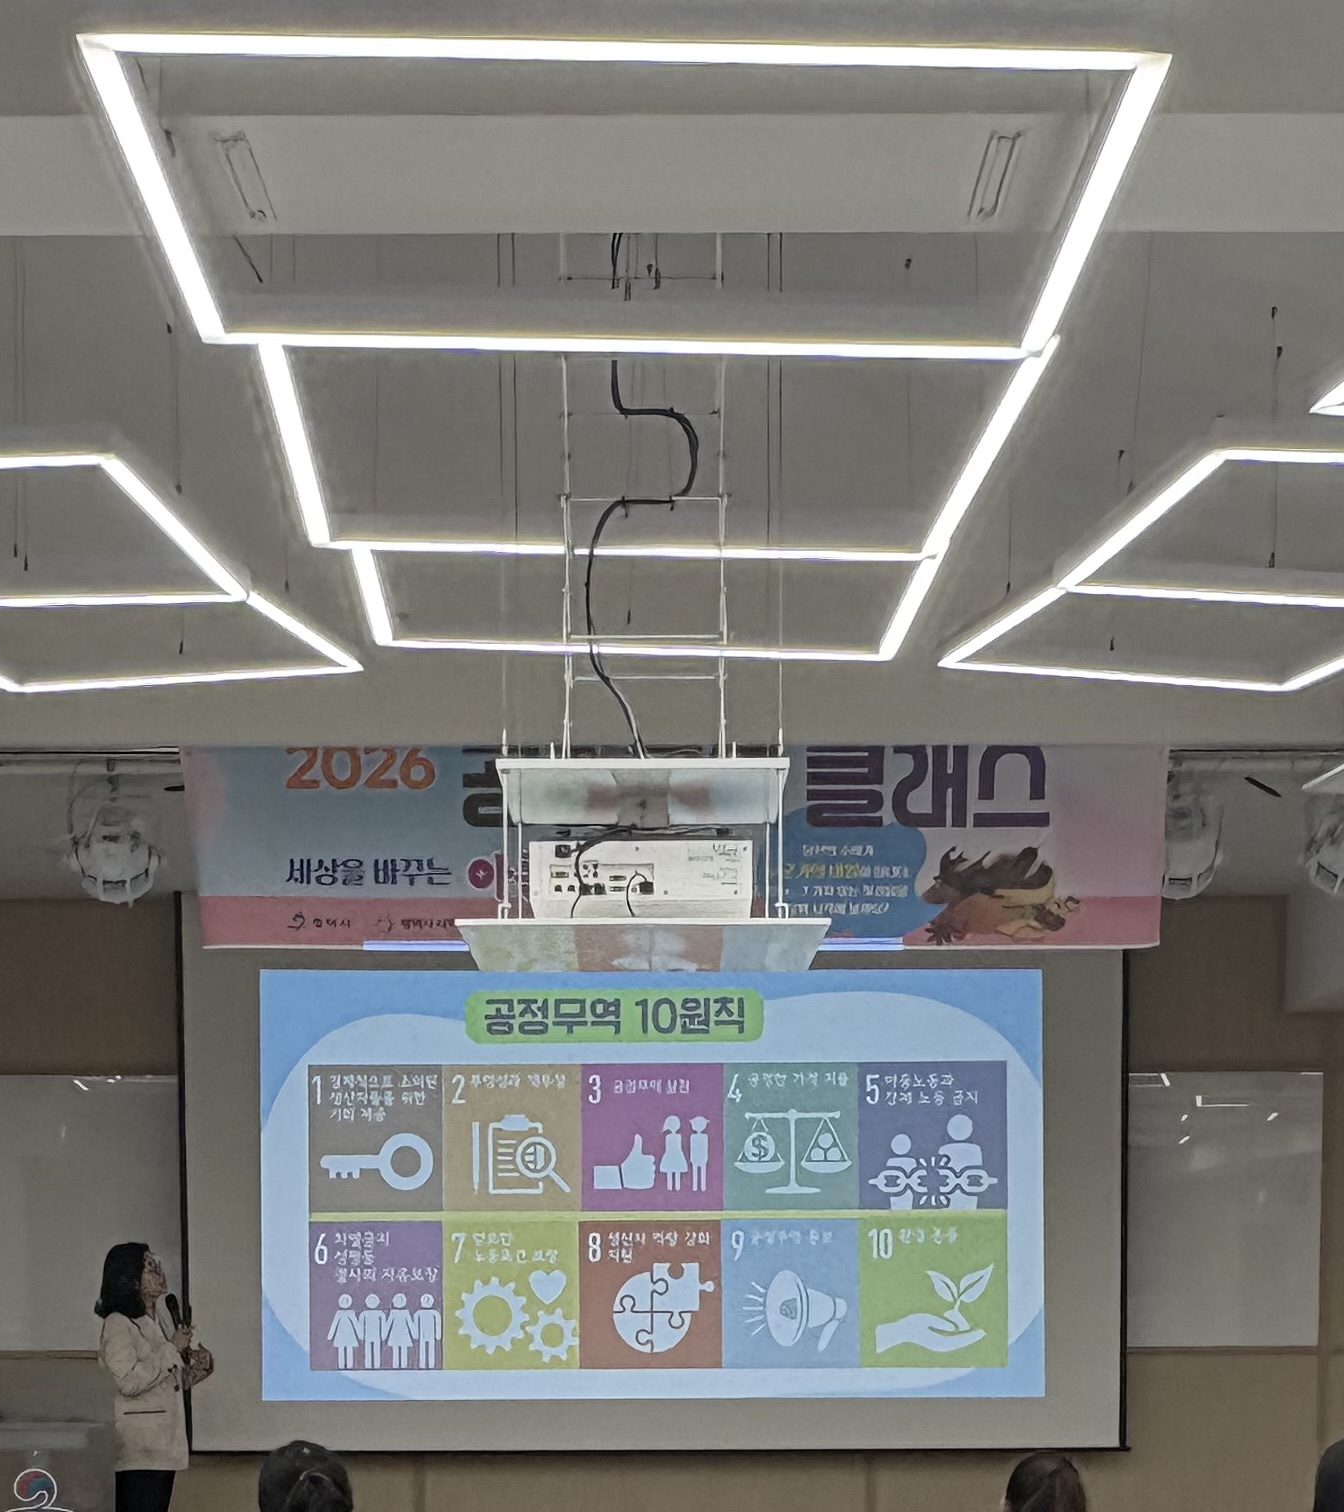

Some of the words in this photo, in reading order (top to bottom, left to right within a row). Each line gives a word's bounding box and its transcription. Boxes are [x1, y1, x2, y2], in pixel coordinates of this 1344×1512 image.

[285, 746, 437, 790] 2026
[806, 745, 1051, 828] 클래스
[286, 857, 365, 887] 세상을
[373, 856, 453, 886] 바꾸는
[484, 997, 622, 1036] 공정무역
[634, 996, 746, 1035] 10원칙
[311, 1074, 322, 1105] 1
[451, 1074, 466, 1104] 2
[588, 1074, 602, 1104] 3
[726, 1073, 743, 1103] 4
[865, 1074, 880, 1105] 5
[314, 1232, 328, 1265] 6
[451, 1232, 466, 1264] 7
[588, 1232, 602, 1263] 8
[730, 1230, 745, 1261] 9
[868, 1228, 893, 1259] 10
